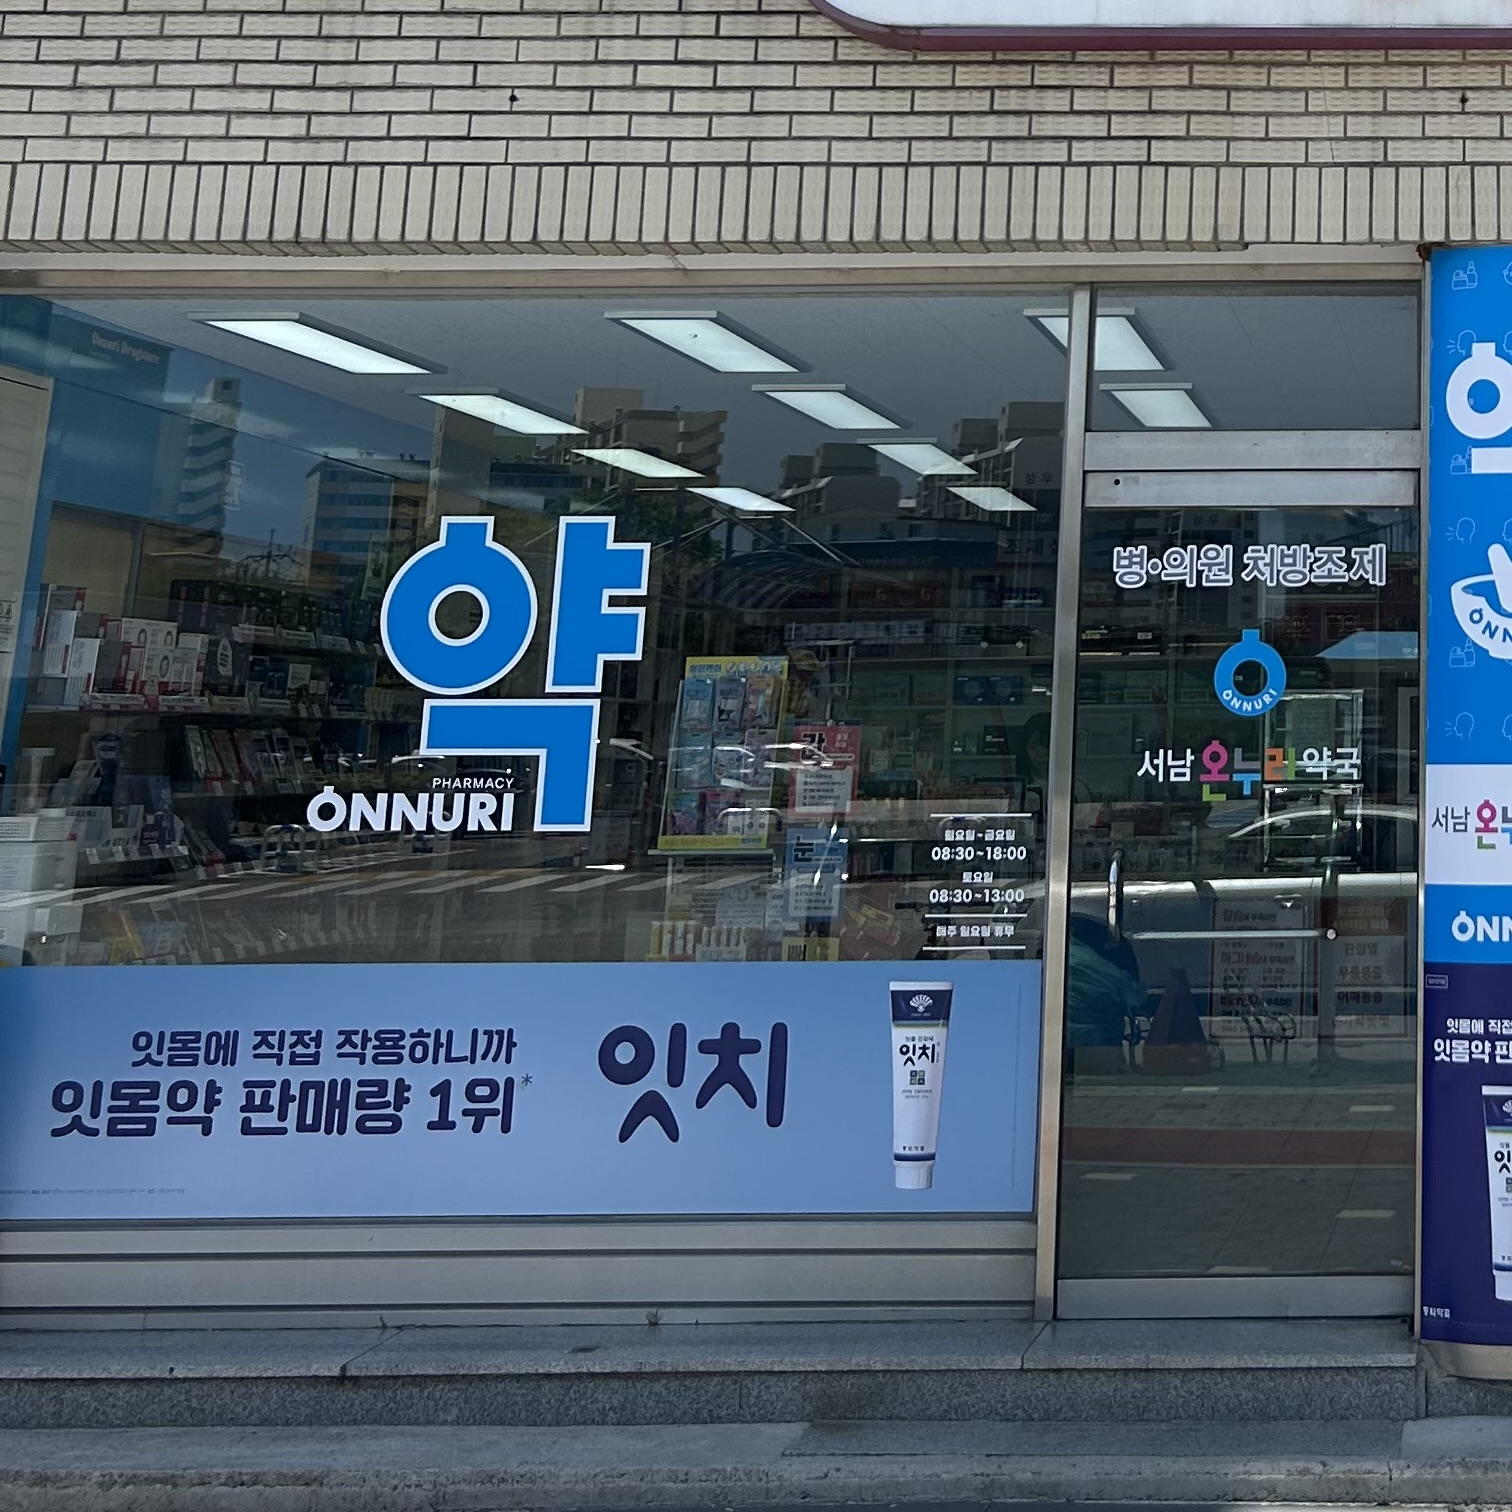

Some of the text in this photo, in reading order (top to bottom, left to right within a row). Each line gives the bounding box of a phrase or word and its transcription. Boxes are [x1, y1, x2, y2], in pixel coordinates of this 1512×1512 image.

[1241, 543, 1387, 588] 처방조제
[380, 516, 651, 832] 약
[1222, 688, 1278, 712] ONNURI
[432, 777, 515, 789] PHARMACY
[306, 785, 514, 833] ONNURI
[959, 925, 991, 938] 일요일
[131, 1027, 518, 1068] 잇몸에 직접 작용하니까
[899, 1043, 936, 1068] 잇치
[1433, 1038, 1492, 1065] 잇몸약
[598, 1021, 788, 1144] 잇치
[50, 1078, 223, 1138] 잇몸약
[239, 1076, 412, 1137] 판매량
